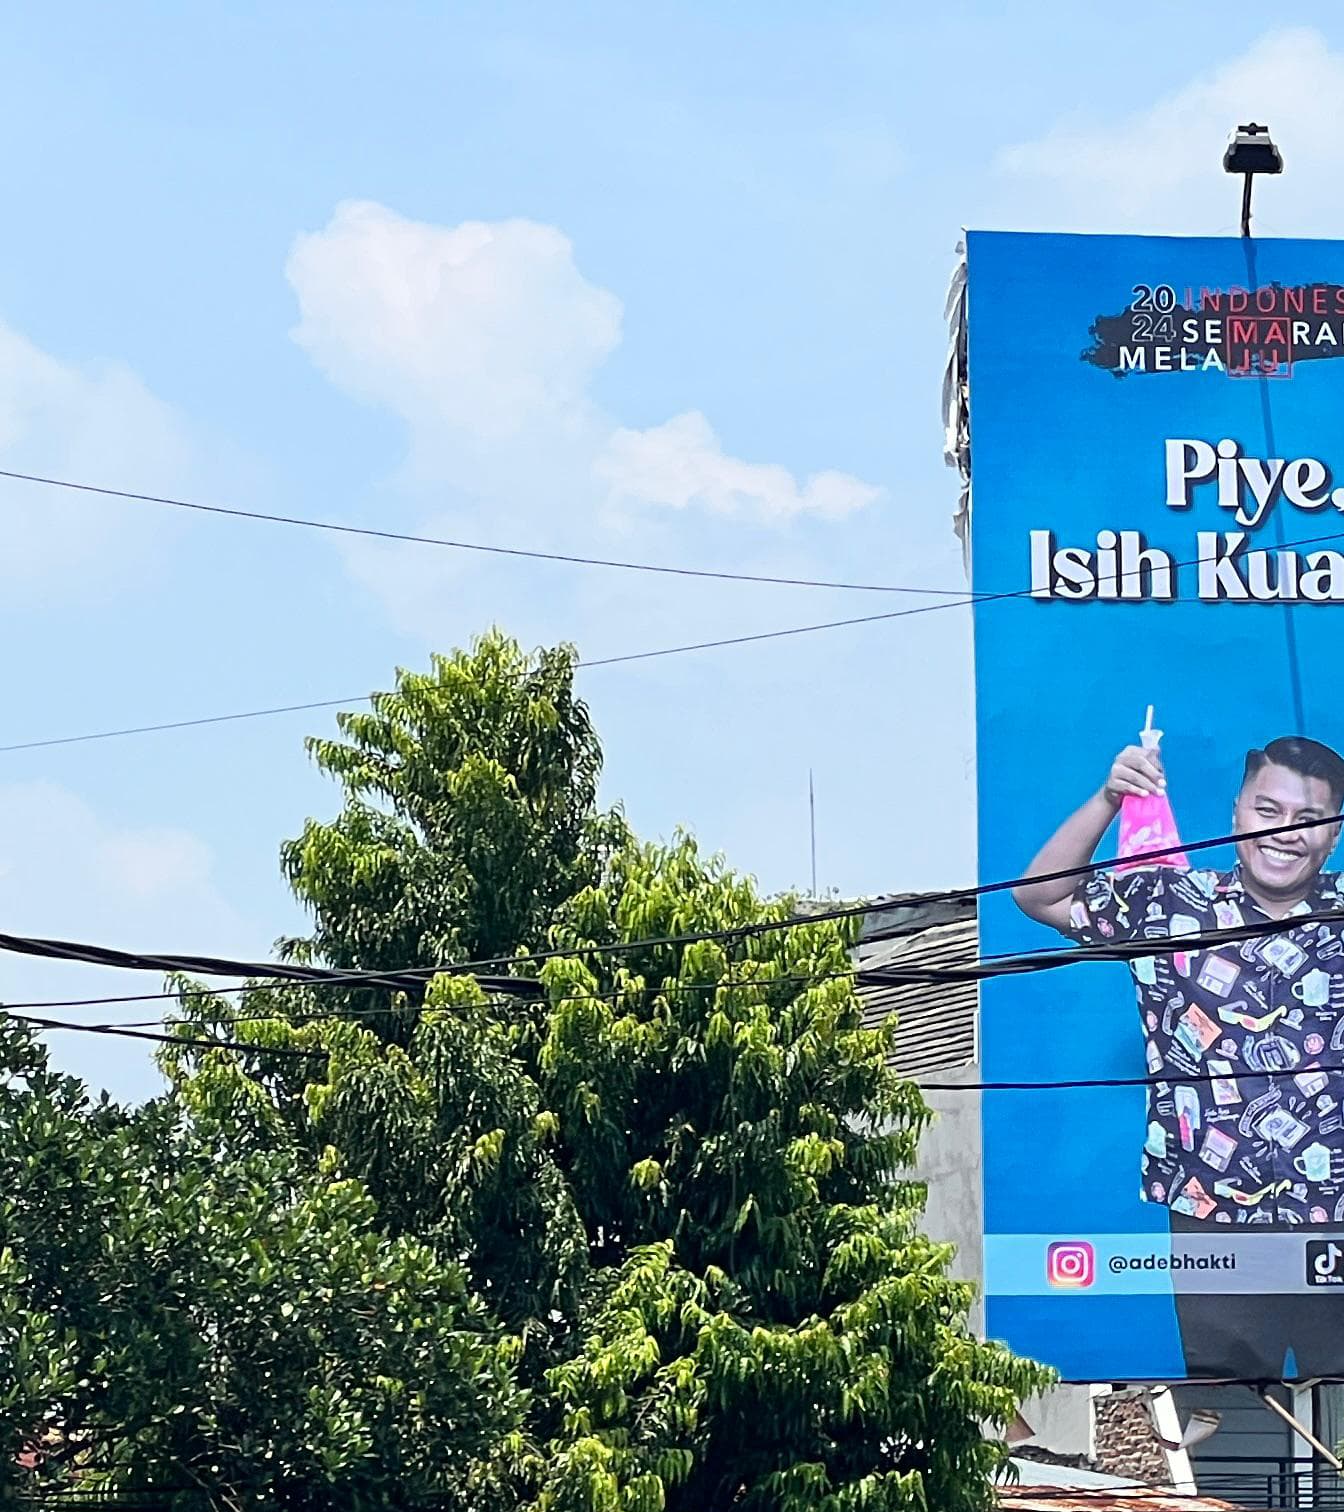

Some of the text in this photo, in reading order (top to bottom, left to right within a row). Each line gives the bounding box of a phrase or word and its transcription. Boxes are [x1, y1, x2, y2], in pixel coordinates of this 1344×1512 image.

[1131, 284, 1176, 313] 20
[1131, 314, 1177, 342] 24
[1030, 530, 1172, 600] Isih
[1109, 1253, 1236, 1273] @adebhakti
